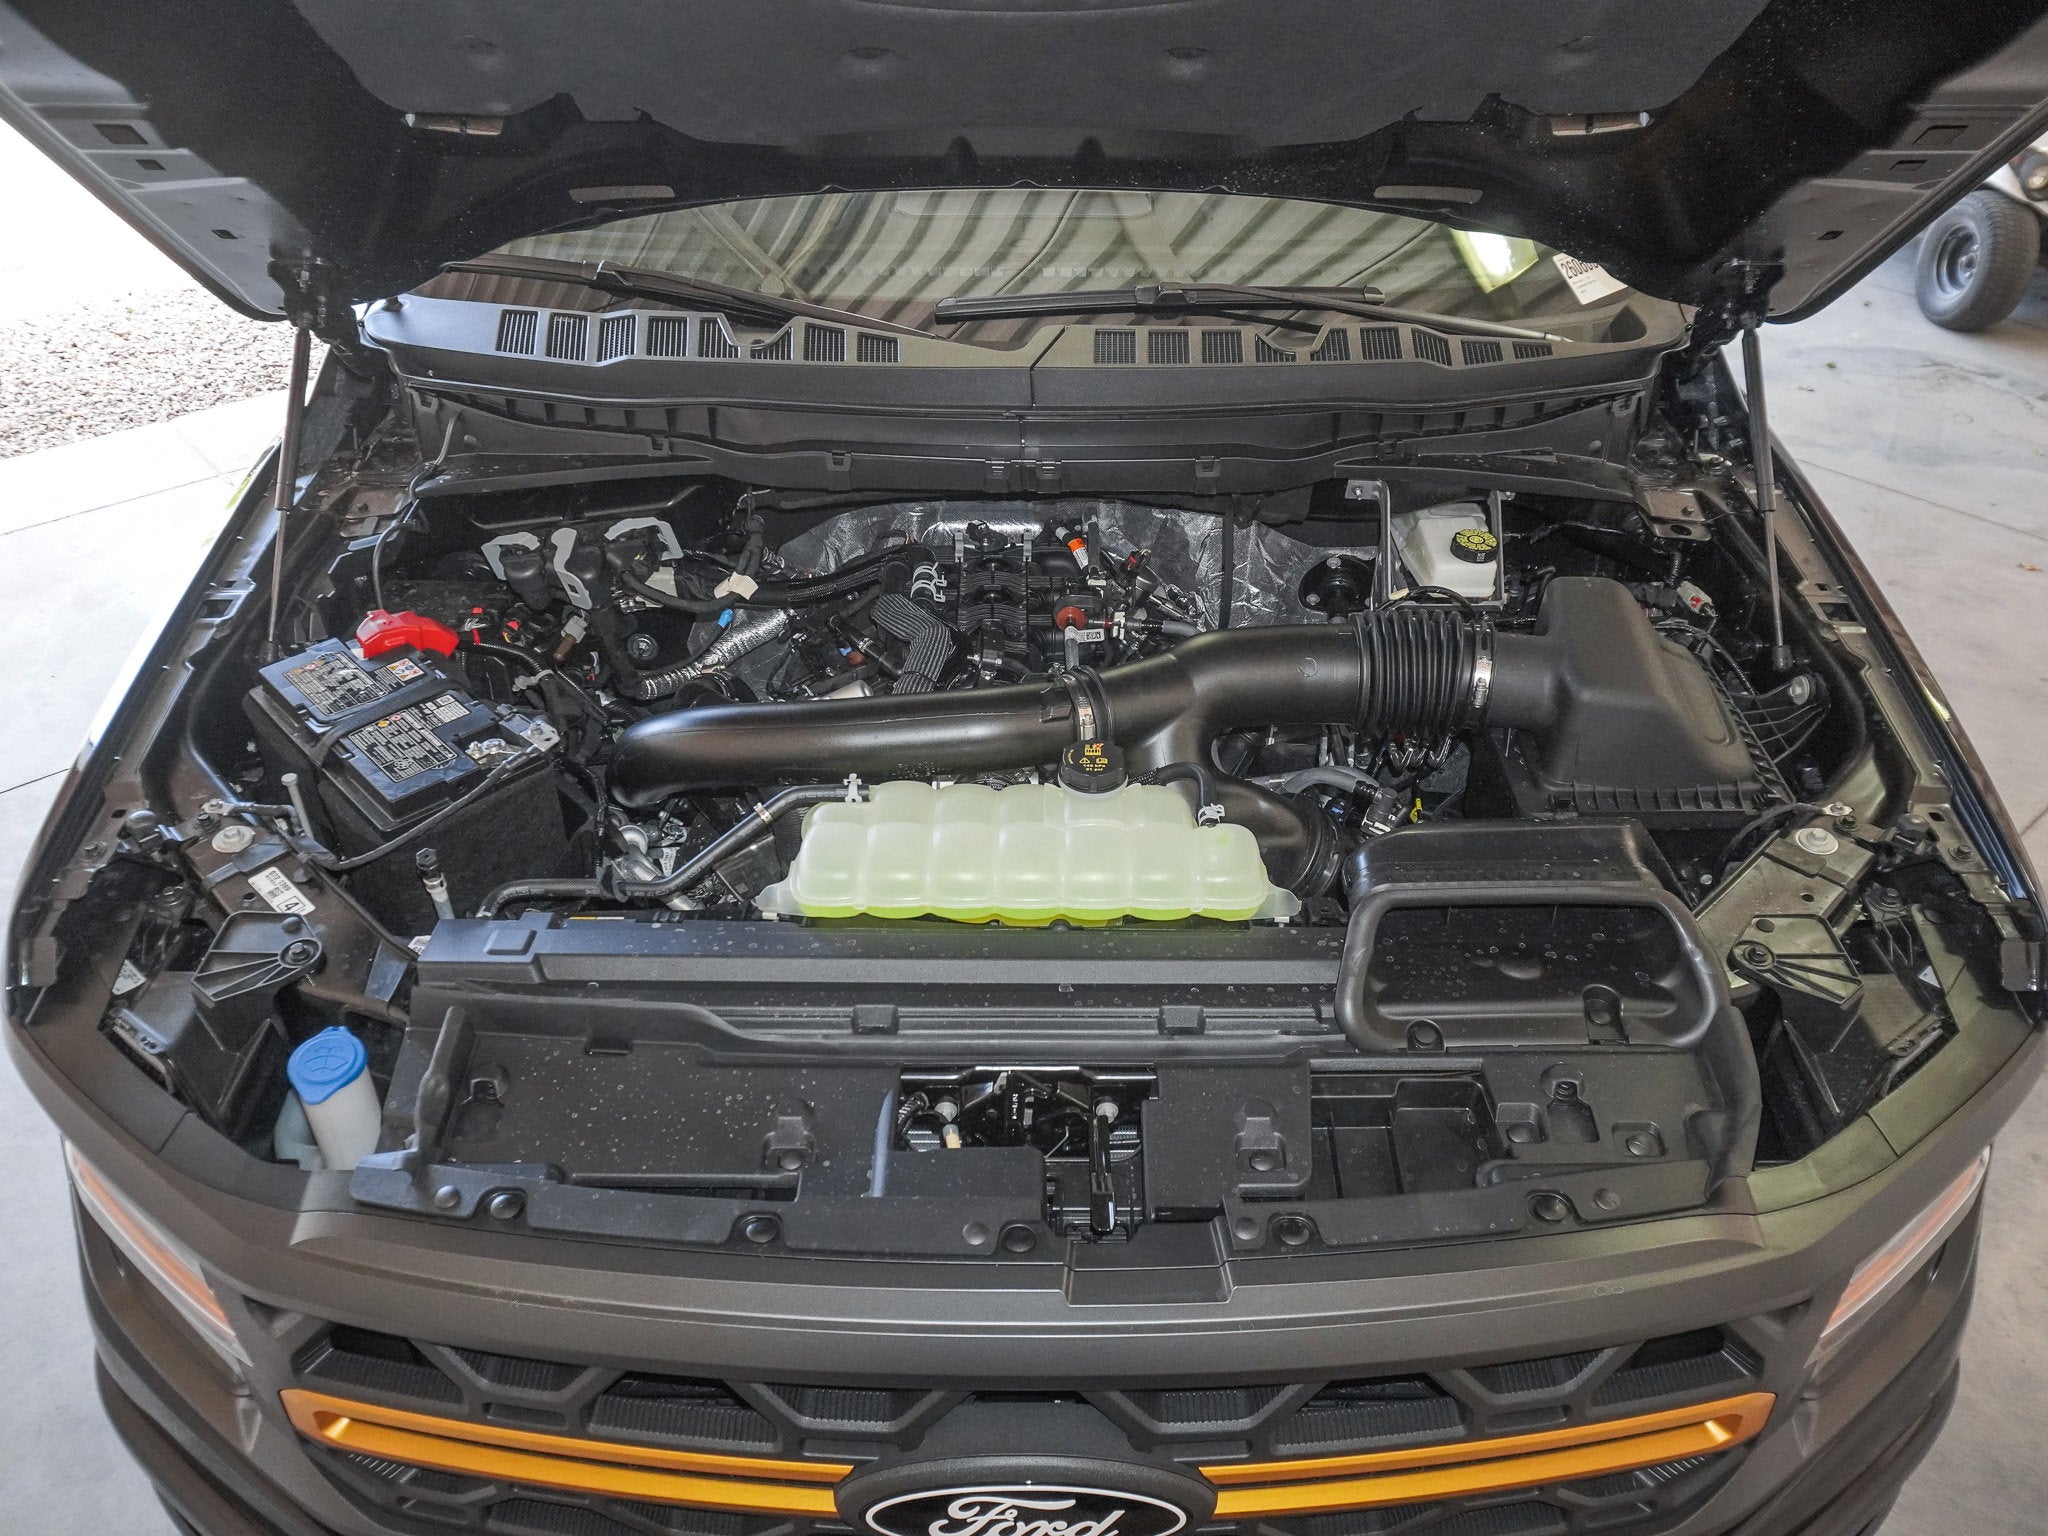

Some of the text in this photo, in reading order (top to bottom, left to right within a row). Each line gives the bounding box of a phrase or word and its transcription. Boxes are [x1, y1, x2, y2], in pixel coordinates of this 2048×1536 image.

[1561, 259, 1598, 278] 2606
[284, 902, 300, 912] 4
[928, 1496, 1127, 1536] Ford
